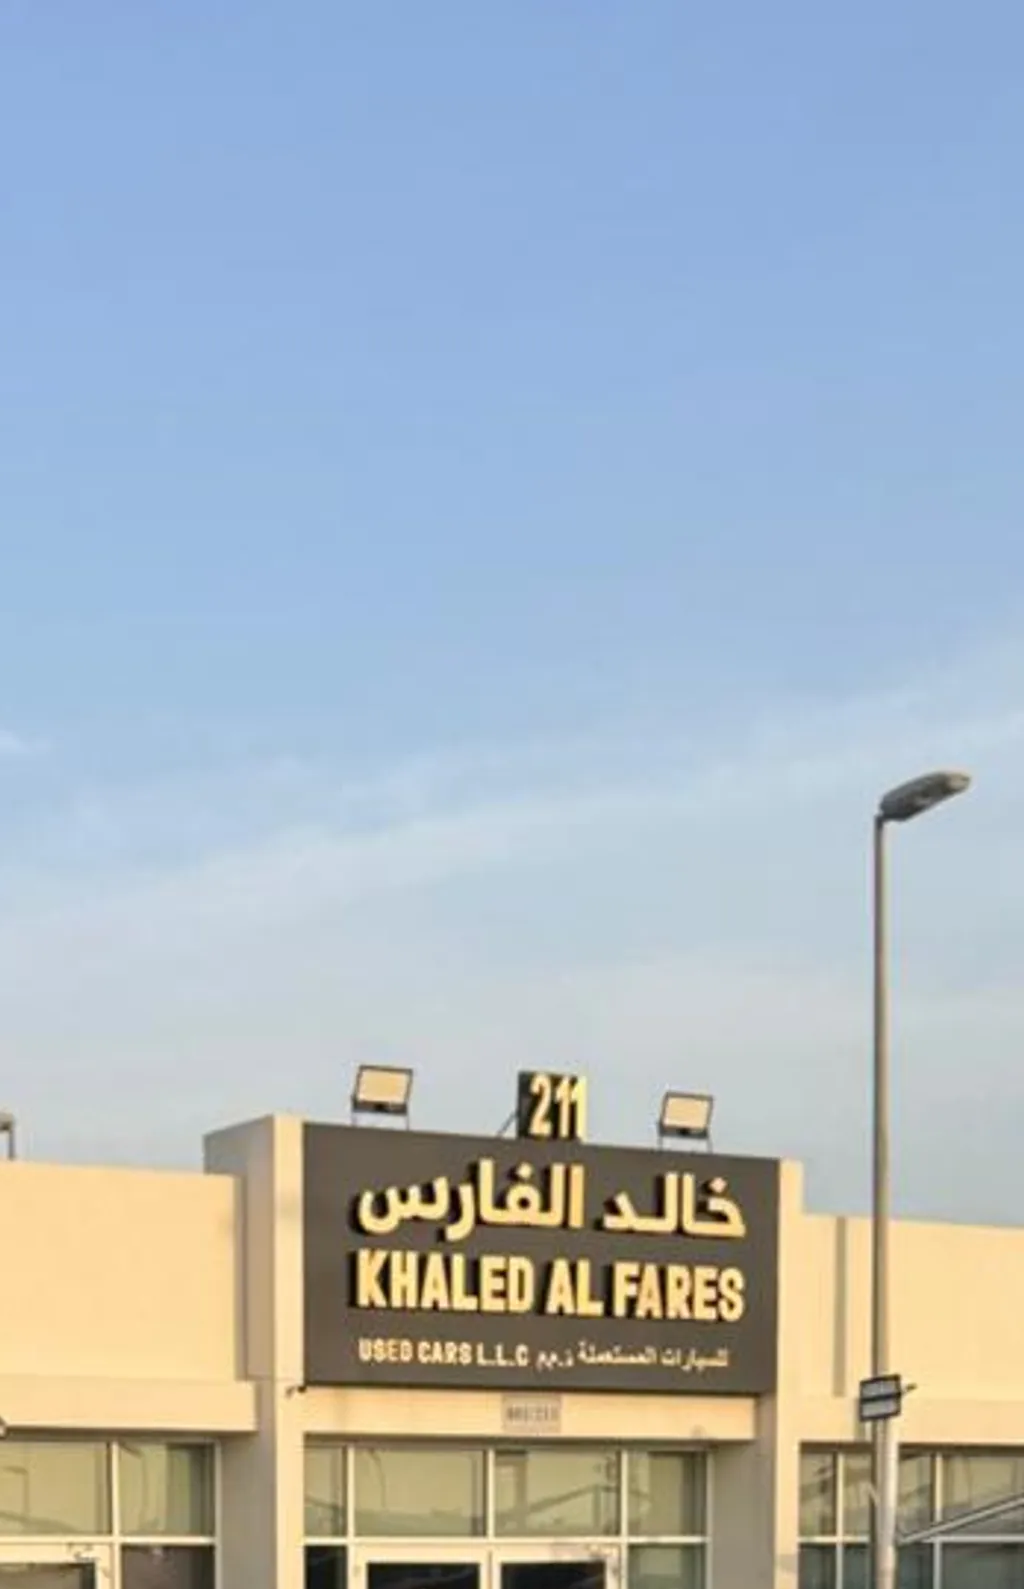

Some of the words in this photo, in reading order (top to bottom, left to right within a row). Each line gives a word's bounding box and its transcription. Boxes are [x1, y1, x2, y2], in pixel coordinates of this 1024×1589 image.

[529, 1072, 588, 1142] 211
[357, 1157, 585, 1242] الفارس
[603, 1171, 747, 1239] خالد
[356, 1247, 535, 1314] KHALED
[545, 1257, 605, 1317] AL
[612, 1261, 747, 1323] FARES
[358, 1337, 414, 1363] USED
[417, 1340, 473, 1366] CARS
